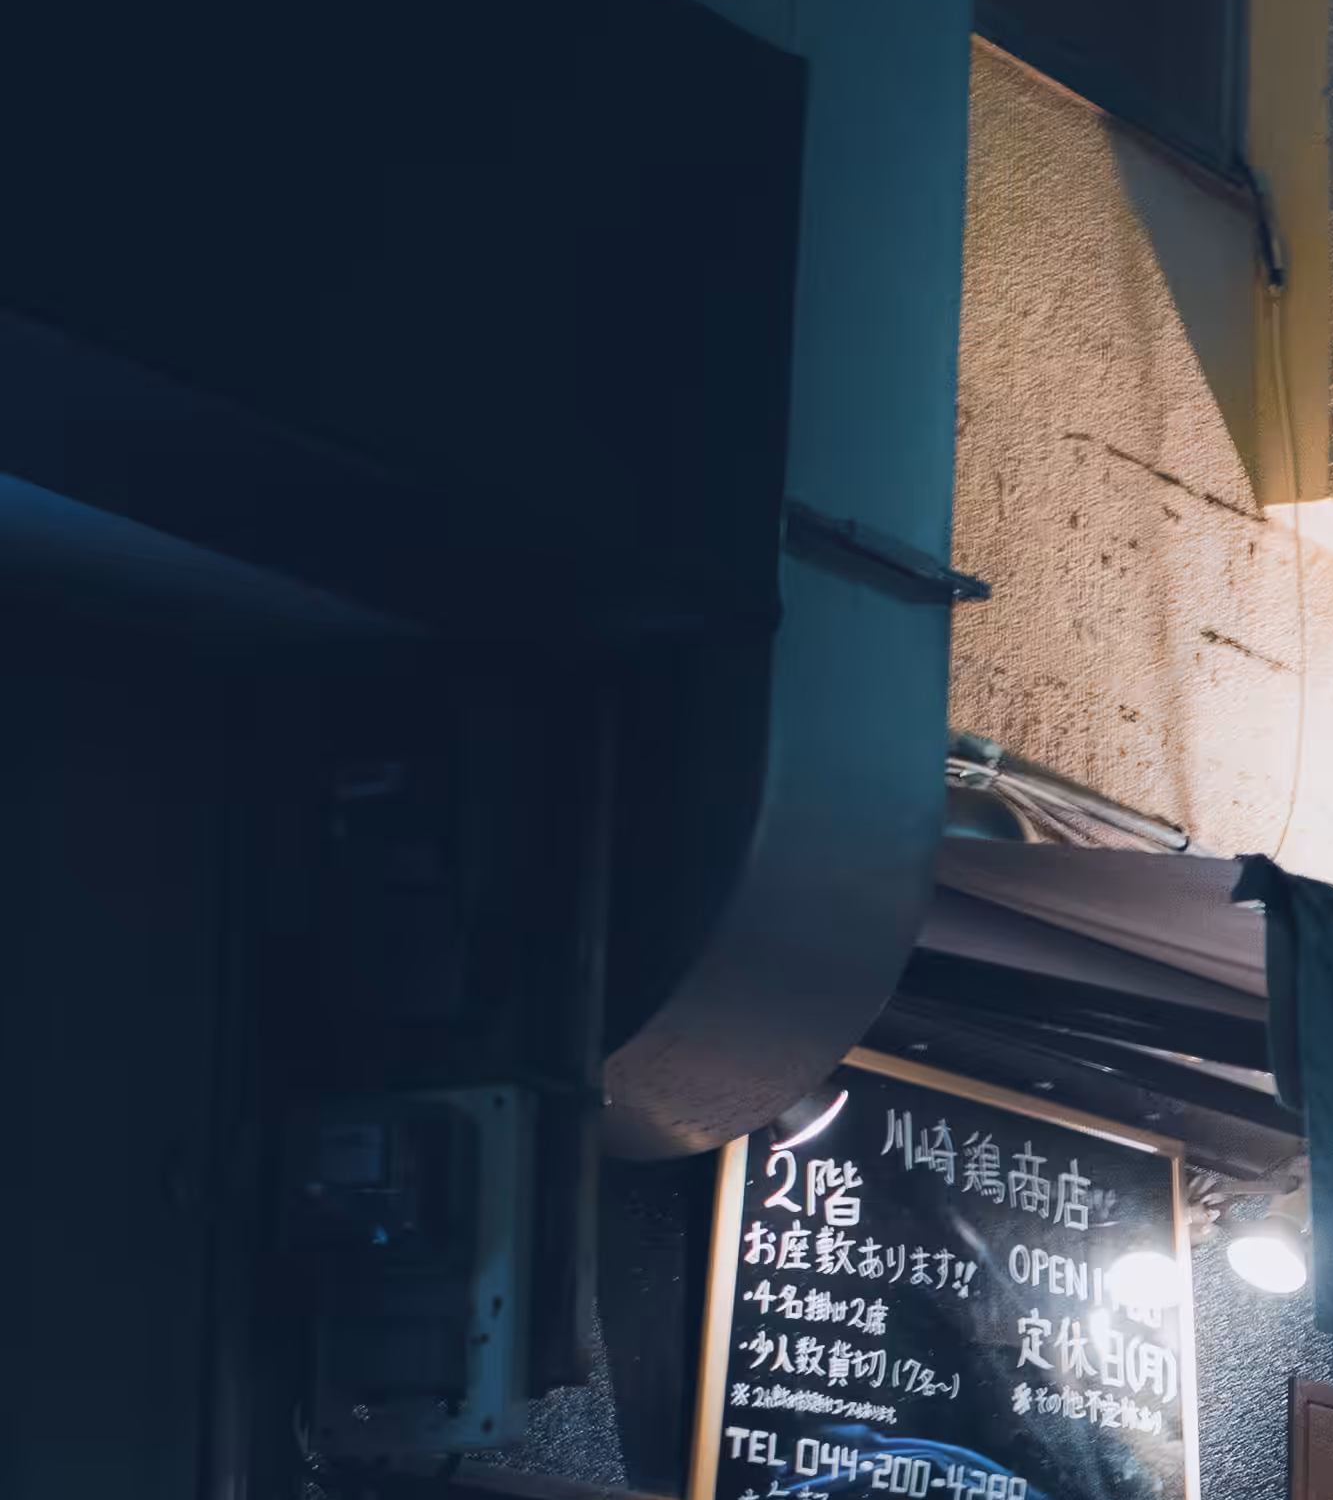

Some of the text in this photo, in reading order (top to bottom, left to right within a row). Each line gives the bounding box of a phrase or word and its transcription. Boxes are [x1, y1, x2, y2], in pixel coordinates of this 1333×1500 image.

[763, 1149, 863, 1226] 2階
[880, 1108, 1091, 1231] 川崎鶏商店
[1008, 1244, 1088, 1301] OPEN
[725, 1426, 787, 1467] TEL
